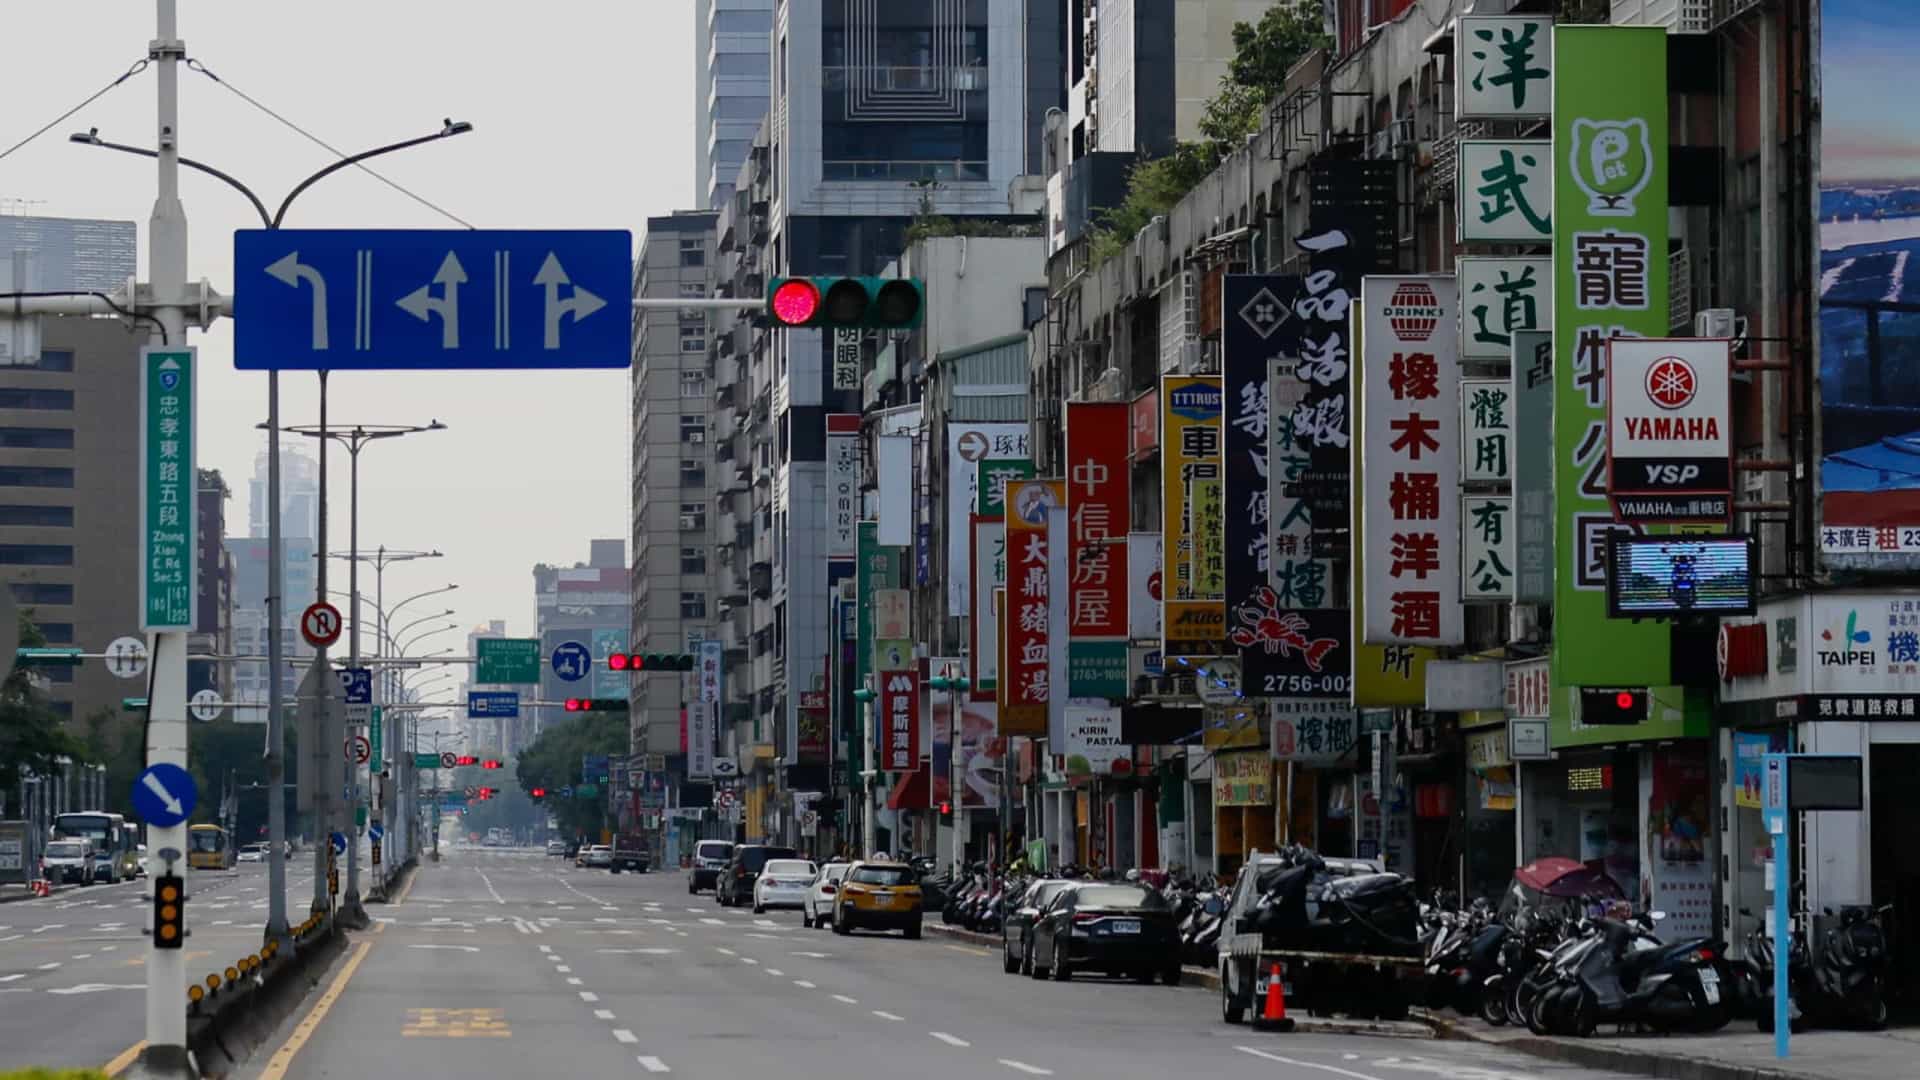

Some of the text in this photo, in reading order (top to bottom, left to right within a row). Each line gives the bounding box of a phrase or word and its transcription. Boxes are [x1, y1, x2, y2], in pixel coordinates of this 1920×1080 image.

[1383, 306, 1444, 317] DRINKS
[1173, 391, 1222, 406] TTTRUS
[1624, 416, 1720, 441] YAMAHA
[159, 395, 179, 526] 忠孝東路五段
[1646, 464, 1700, 484] YSP
[1389, 353, 1440, 639] 橡木桶洋酒
[1619, 501, 1673, 514] YAMAHA
[153, 530, 184, 544] Zhong
[1072, 457, 1111, 627] 中信房屋
[153, 544, 177, 556] Xiao
[165, 558, 180, 569] Rd
[1020, 533, 1048, 703] 大鼎豬血湯
[1818, 650, 1876, 665] TAIPEI
[1079, 726, 1108, 735] KIRIN
[1086, 736, 1121, 745] PASTA
